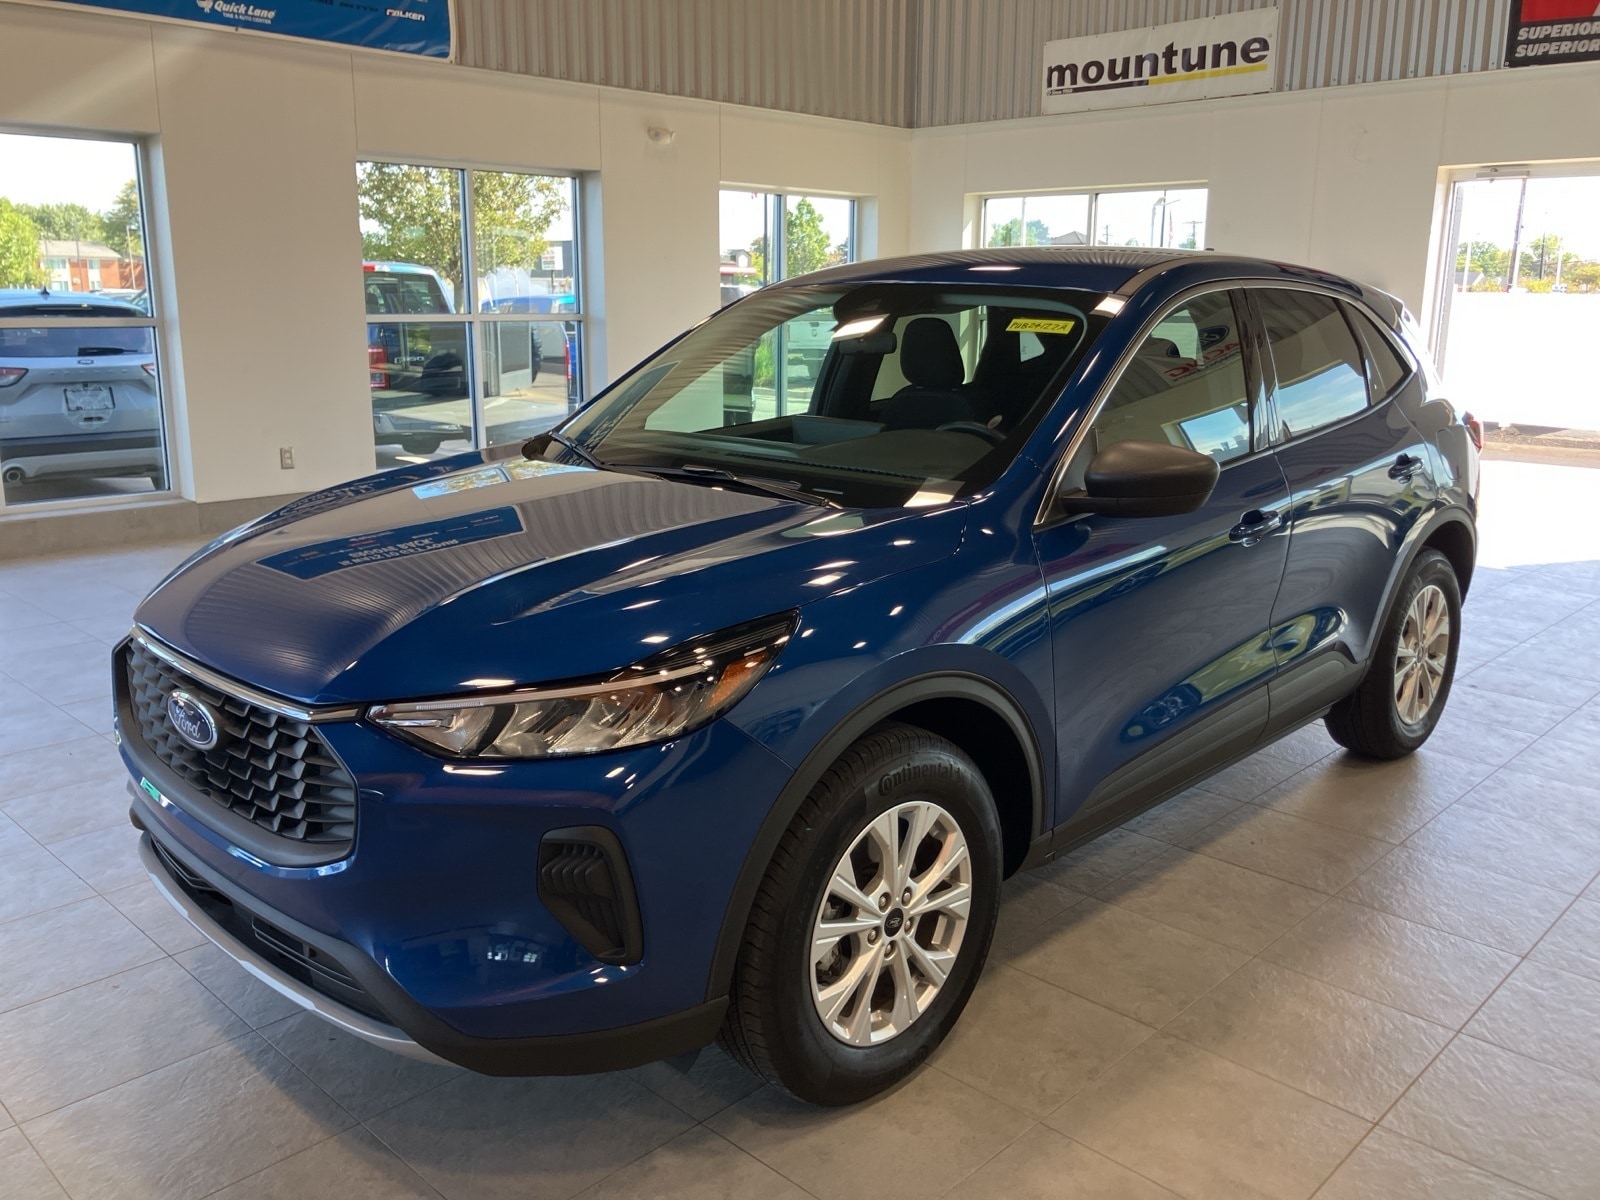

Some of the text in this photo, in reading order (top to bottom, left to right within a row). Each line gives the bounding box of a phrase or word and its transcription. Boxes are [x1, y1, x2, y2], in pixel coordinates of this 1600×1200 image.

[214, 0, 276, 19] Quick Lane
[1517, 22, 1600, 40] SUPERIOR
[1515, 38, 1600, 57] SUPERIOR
[1046, 36, 1271, 88] mountune
[174, 704, 201, 739] Ford
[877, 762, 954, 797] Continental
